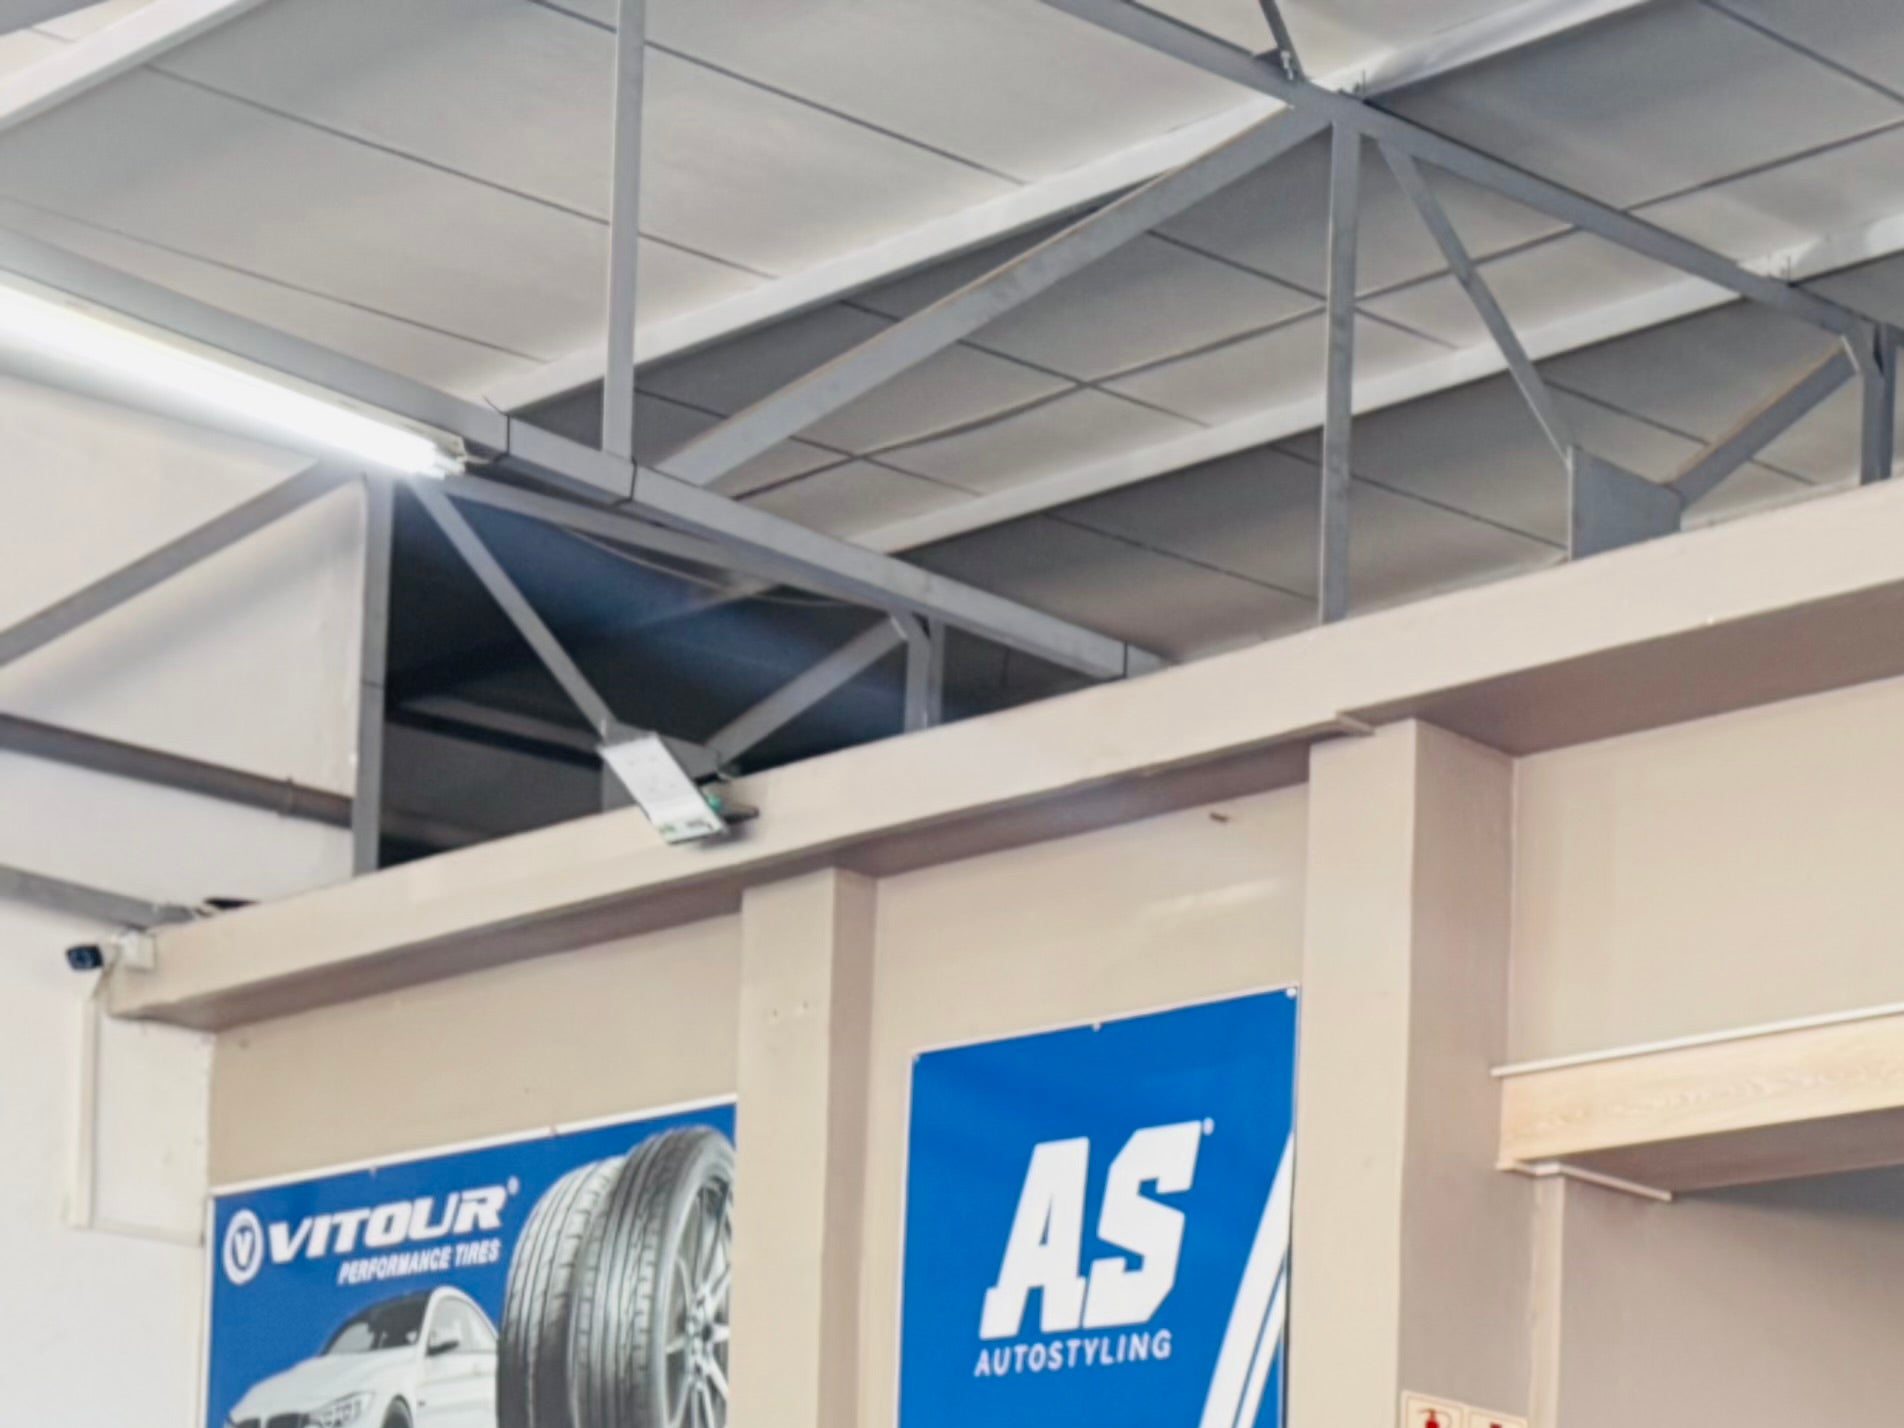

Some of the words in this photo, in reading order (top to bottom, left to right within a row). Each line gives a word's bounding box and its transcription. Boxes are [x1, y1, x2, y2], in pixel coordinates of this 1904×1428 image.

[268, 1184, 507, 1264] VITOUR
[979, 1119, 1204, 1341] AS
[336, 1245, 450, 1286] PERFORMANCE
[455, 1237, 501, 1267] TIRES
[973, 1329, 1173, 1378] AUTOSTYLING
